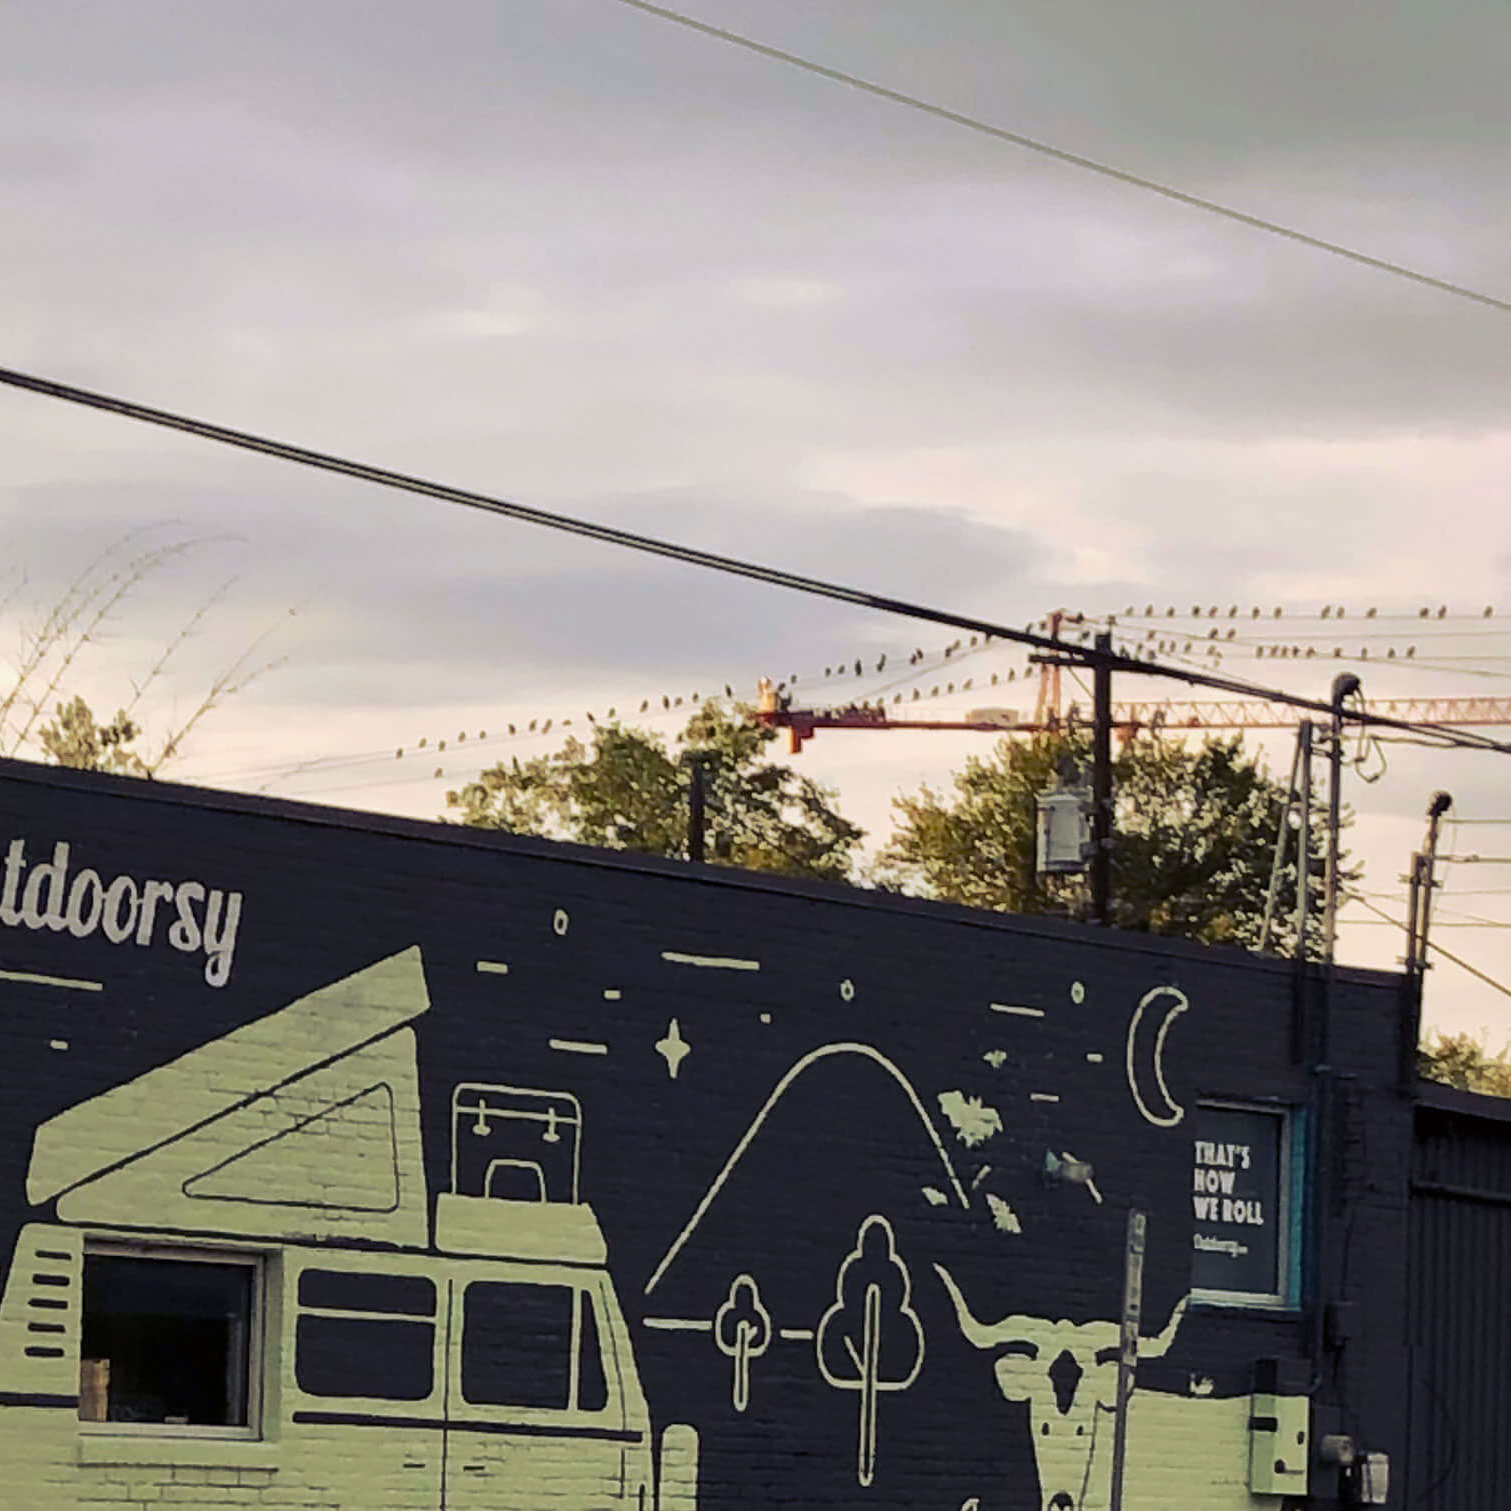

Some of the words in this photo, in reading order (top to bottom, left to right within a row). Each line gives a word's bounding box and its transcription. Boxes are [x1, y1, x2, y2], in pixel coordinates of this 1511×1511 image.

[1194, 1141, 1250, 1169] THAT'S
[1194, 1168, 1236, 1195] HOW
[1192, 1196, 1219, 1221] WE
[1222, 1199, 1264, 1226] ROLL
